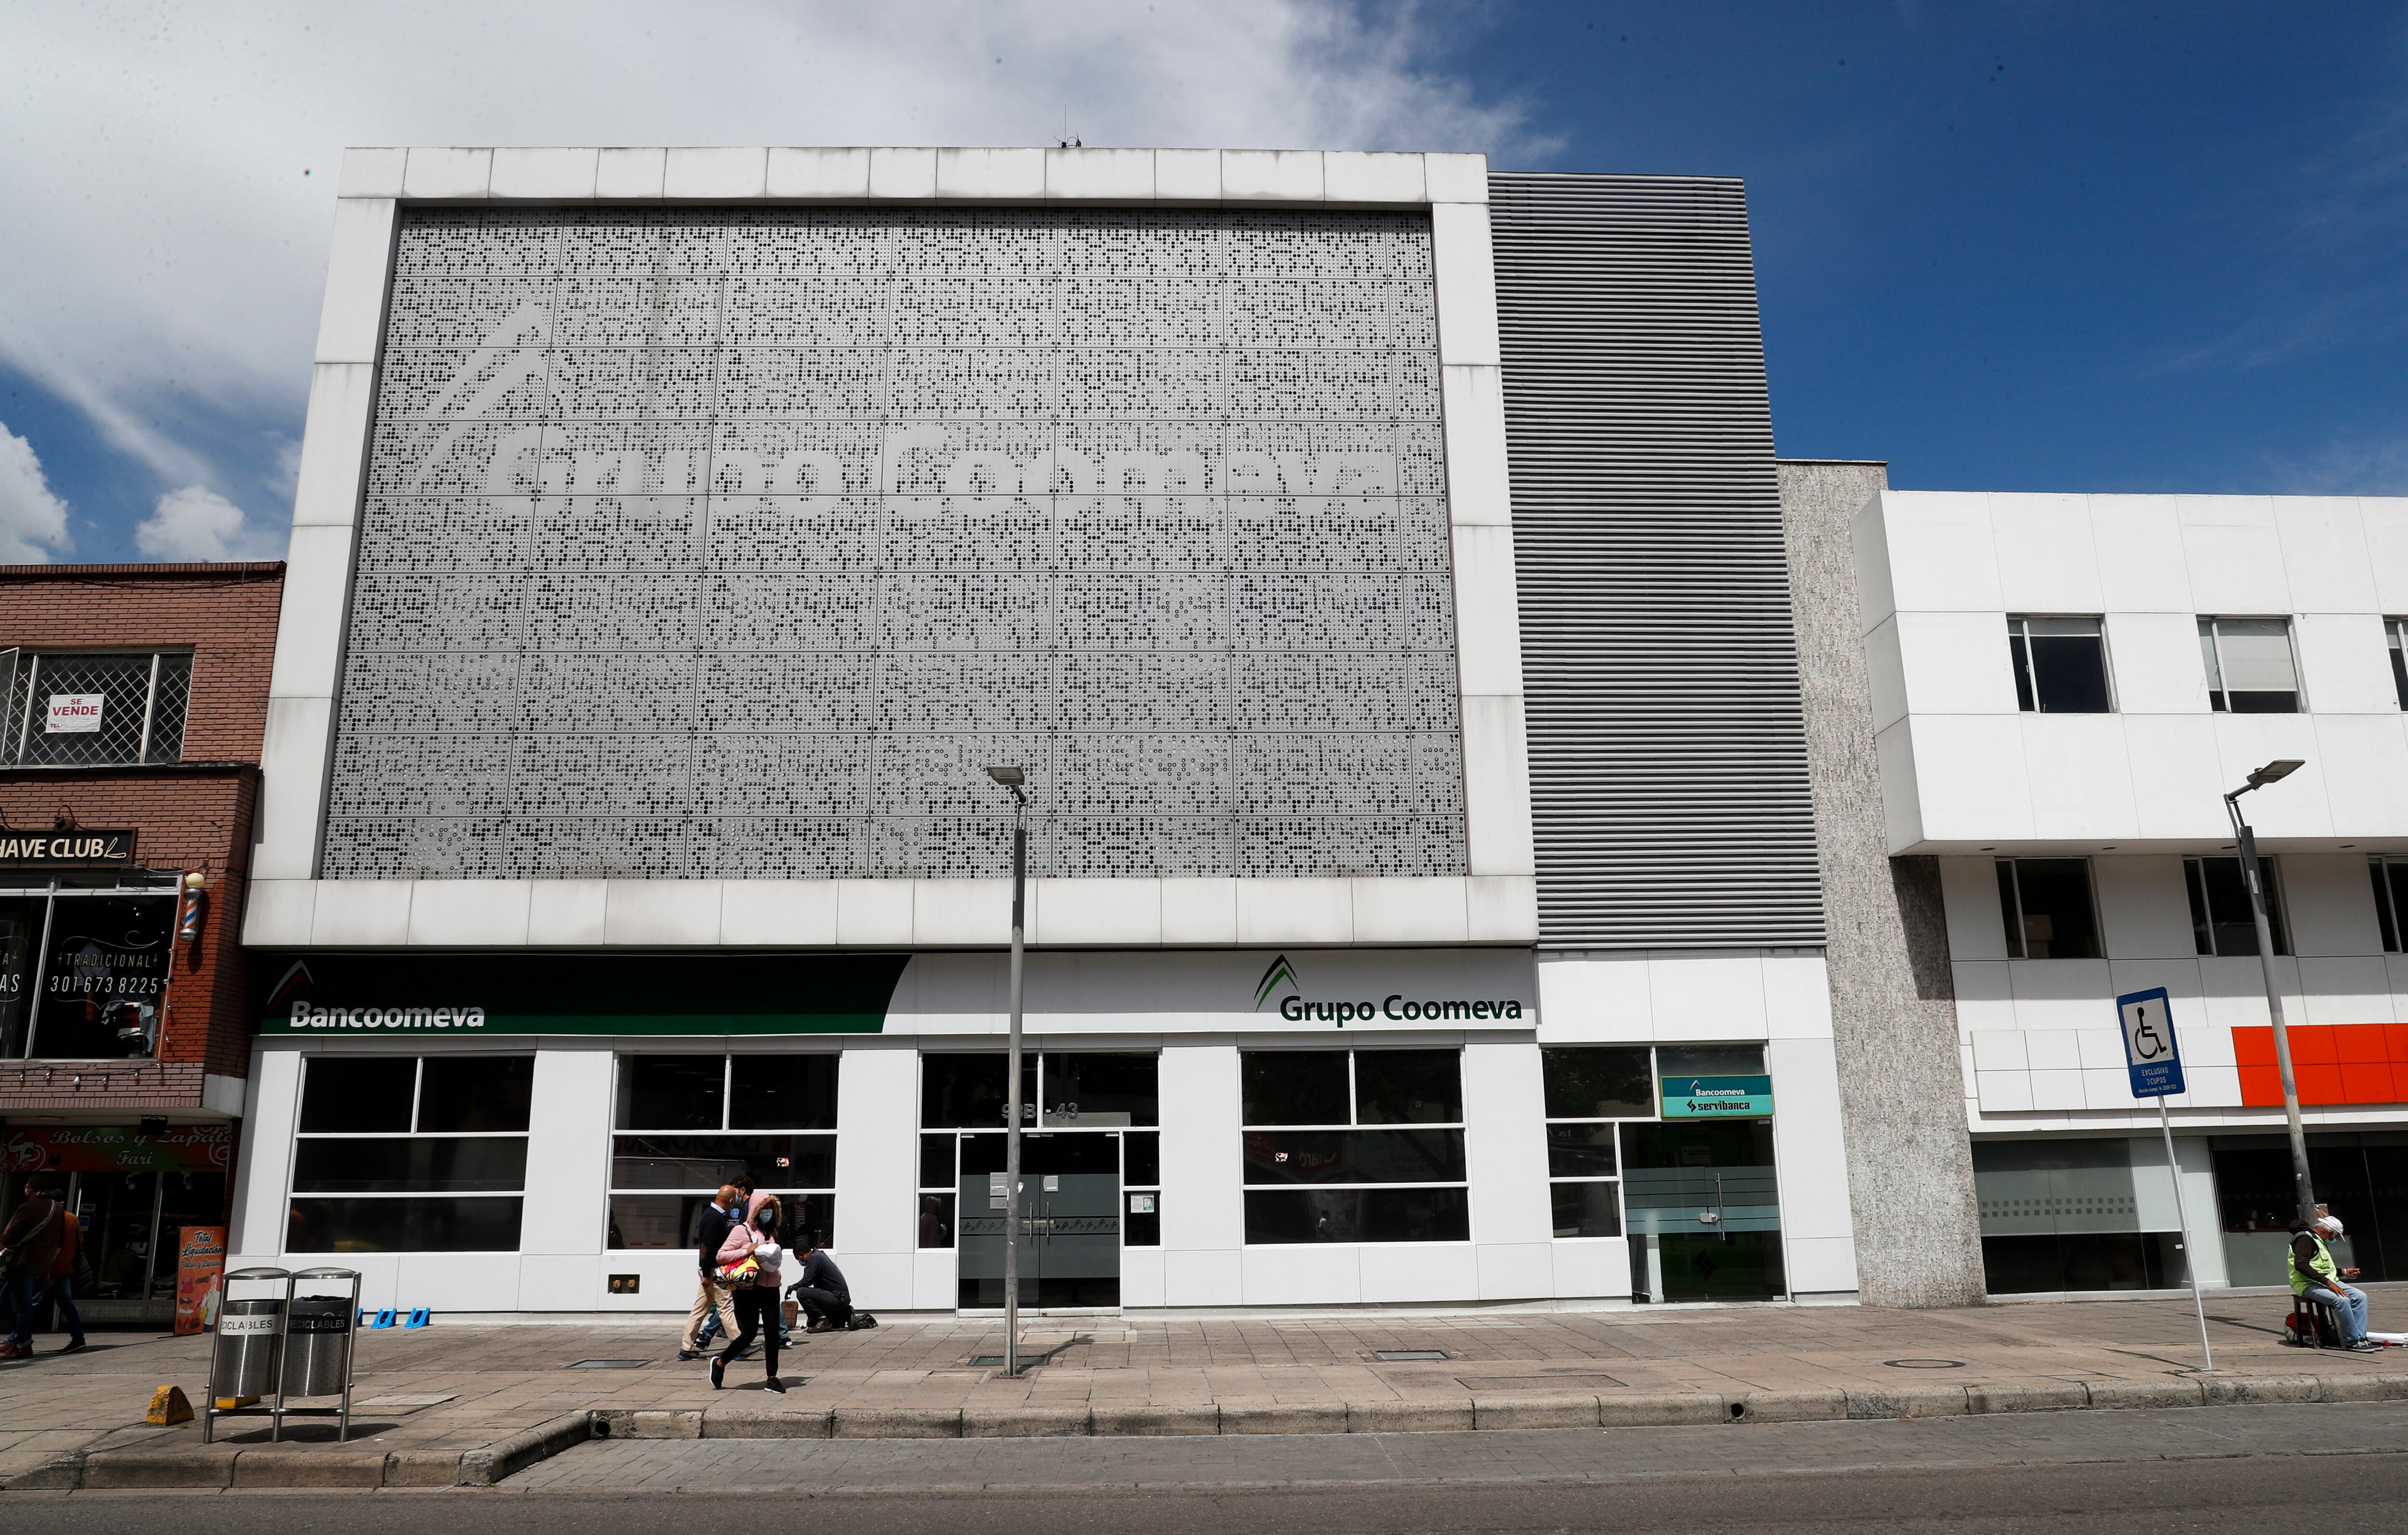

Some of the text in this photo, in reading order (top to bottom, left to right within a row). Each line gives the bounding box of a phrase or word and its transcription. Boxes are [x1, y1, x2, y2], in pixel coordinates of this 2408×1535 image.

[52, 706, 99, 716] VENDE
[50, 838, 104, 858] CLUB
[66, 953, 150, 967] TRADICIONAL
[118, 977, 158, 994] 8225
[290, 1001, 485, 1027] Bancoomeva
[1280, 994, 1522, 1028] Grupo Coomeva
[2142, 1067, 2169, 1077] EXCLUSIVO
[2150, 1077, 2166, 1085] CUPOS
[1056, 1102, 1078, 1119] 43
[1698, 1101, 1750, 1111] servibanca
[49, 1130, 232, 1147] Bolsos y Zapato
[116, 1150, 153, 1165] Fari
[195, 1231, 213, 1244] Total
[182, 1243, 223, 1259] Liquidación
[221, 1319, 273, 1330] ECICLABLES
